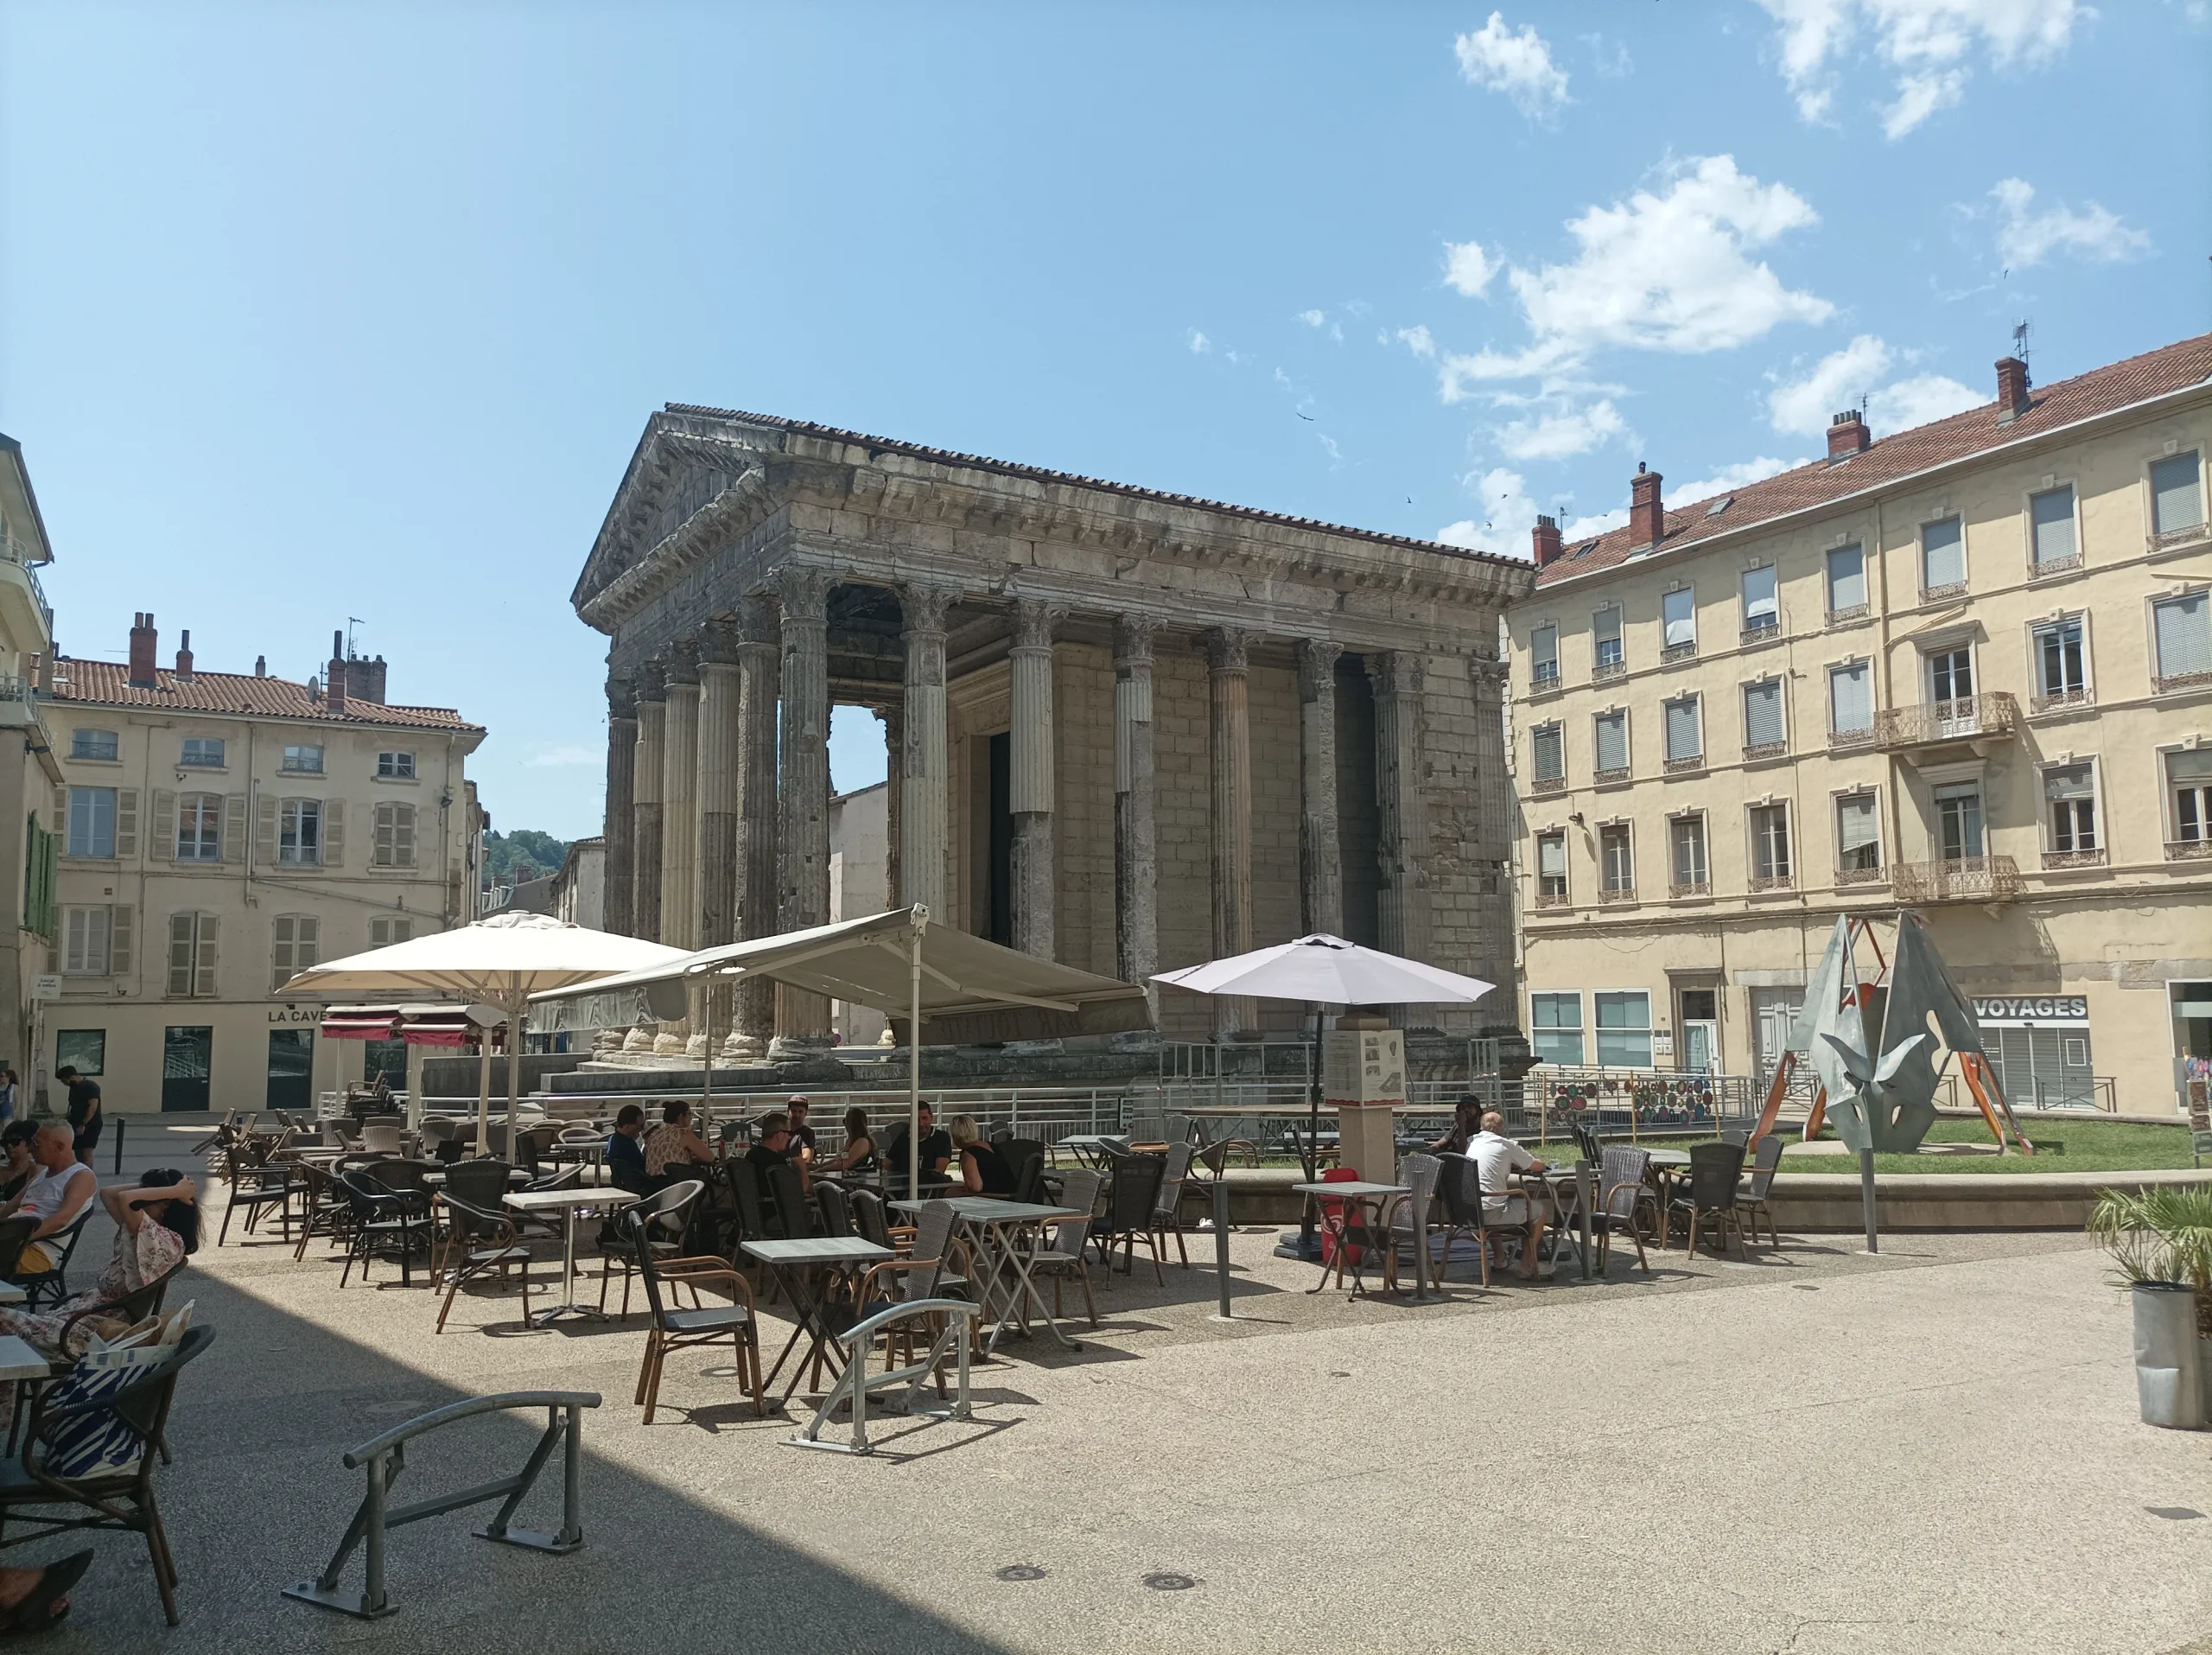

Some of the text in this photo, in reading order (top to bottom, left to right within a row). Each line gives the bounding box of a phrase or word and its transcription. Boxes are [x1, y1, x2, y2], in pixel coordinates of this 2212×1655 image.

[1972, 998, 2087, 1017] VOYAGES
[268, 1010, 327, 1022] LA CAVE
